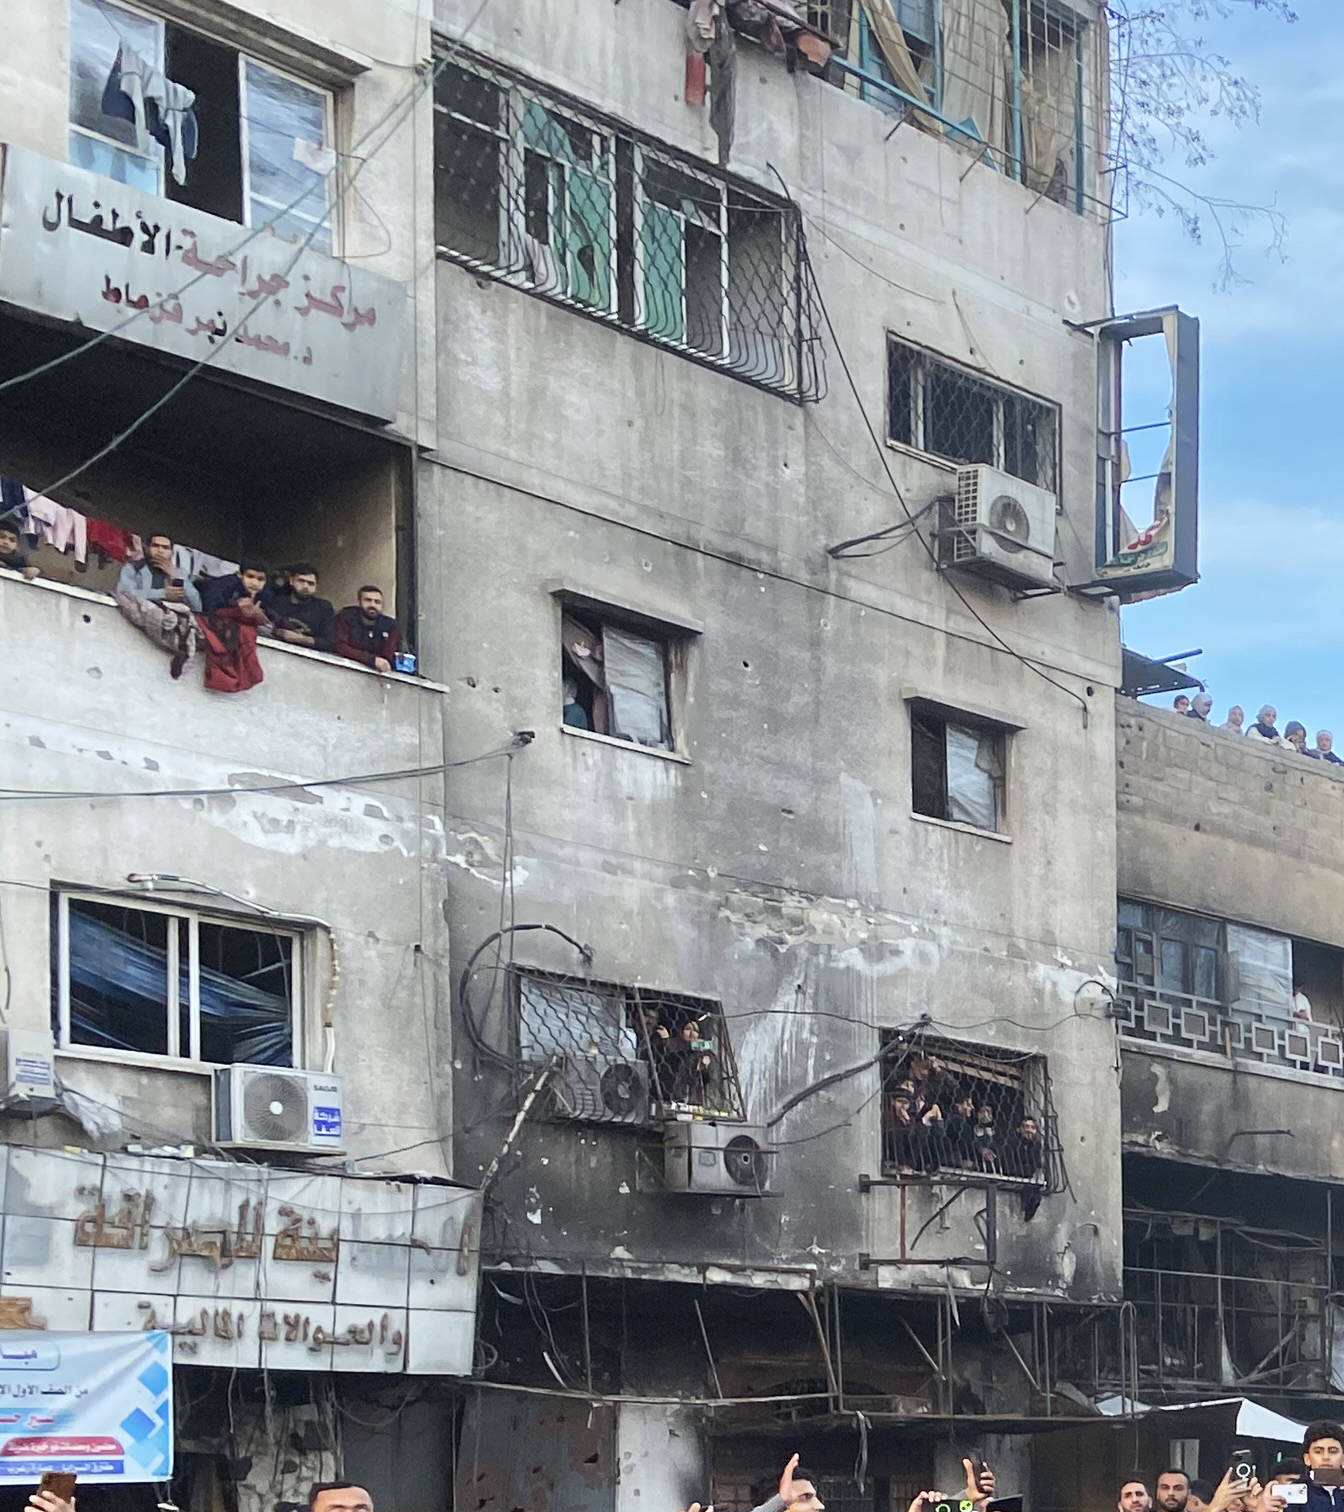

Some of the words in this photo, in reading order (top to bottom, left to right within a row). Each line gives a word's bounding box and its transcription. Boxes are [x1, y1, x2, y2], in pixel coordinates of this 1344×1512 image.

[42, 188, 174, 260] الأطفال
[181, 227, 290, 306] جراحة
[295, 274, 376, 332] مركز
